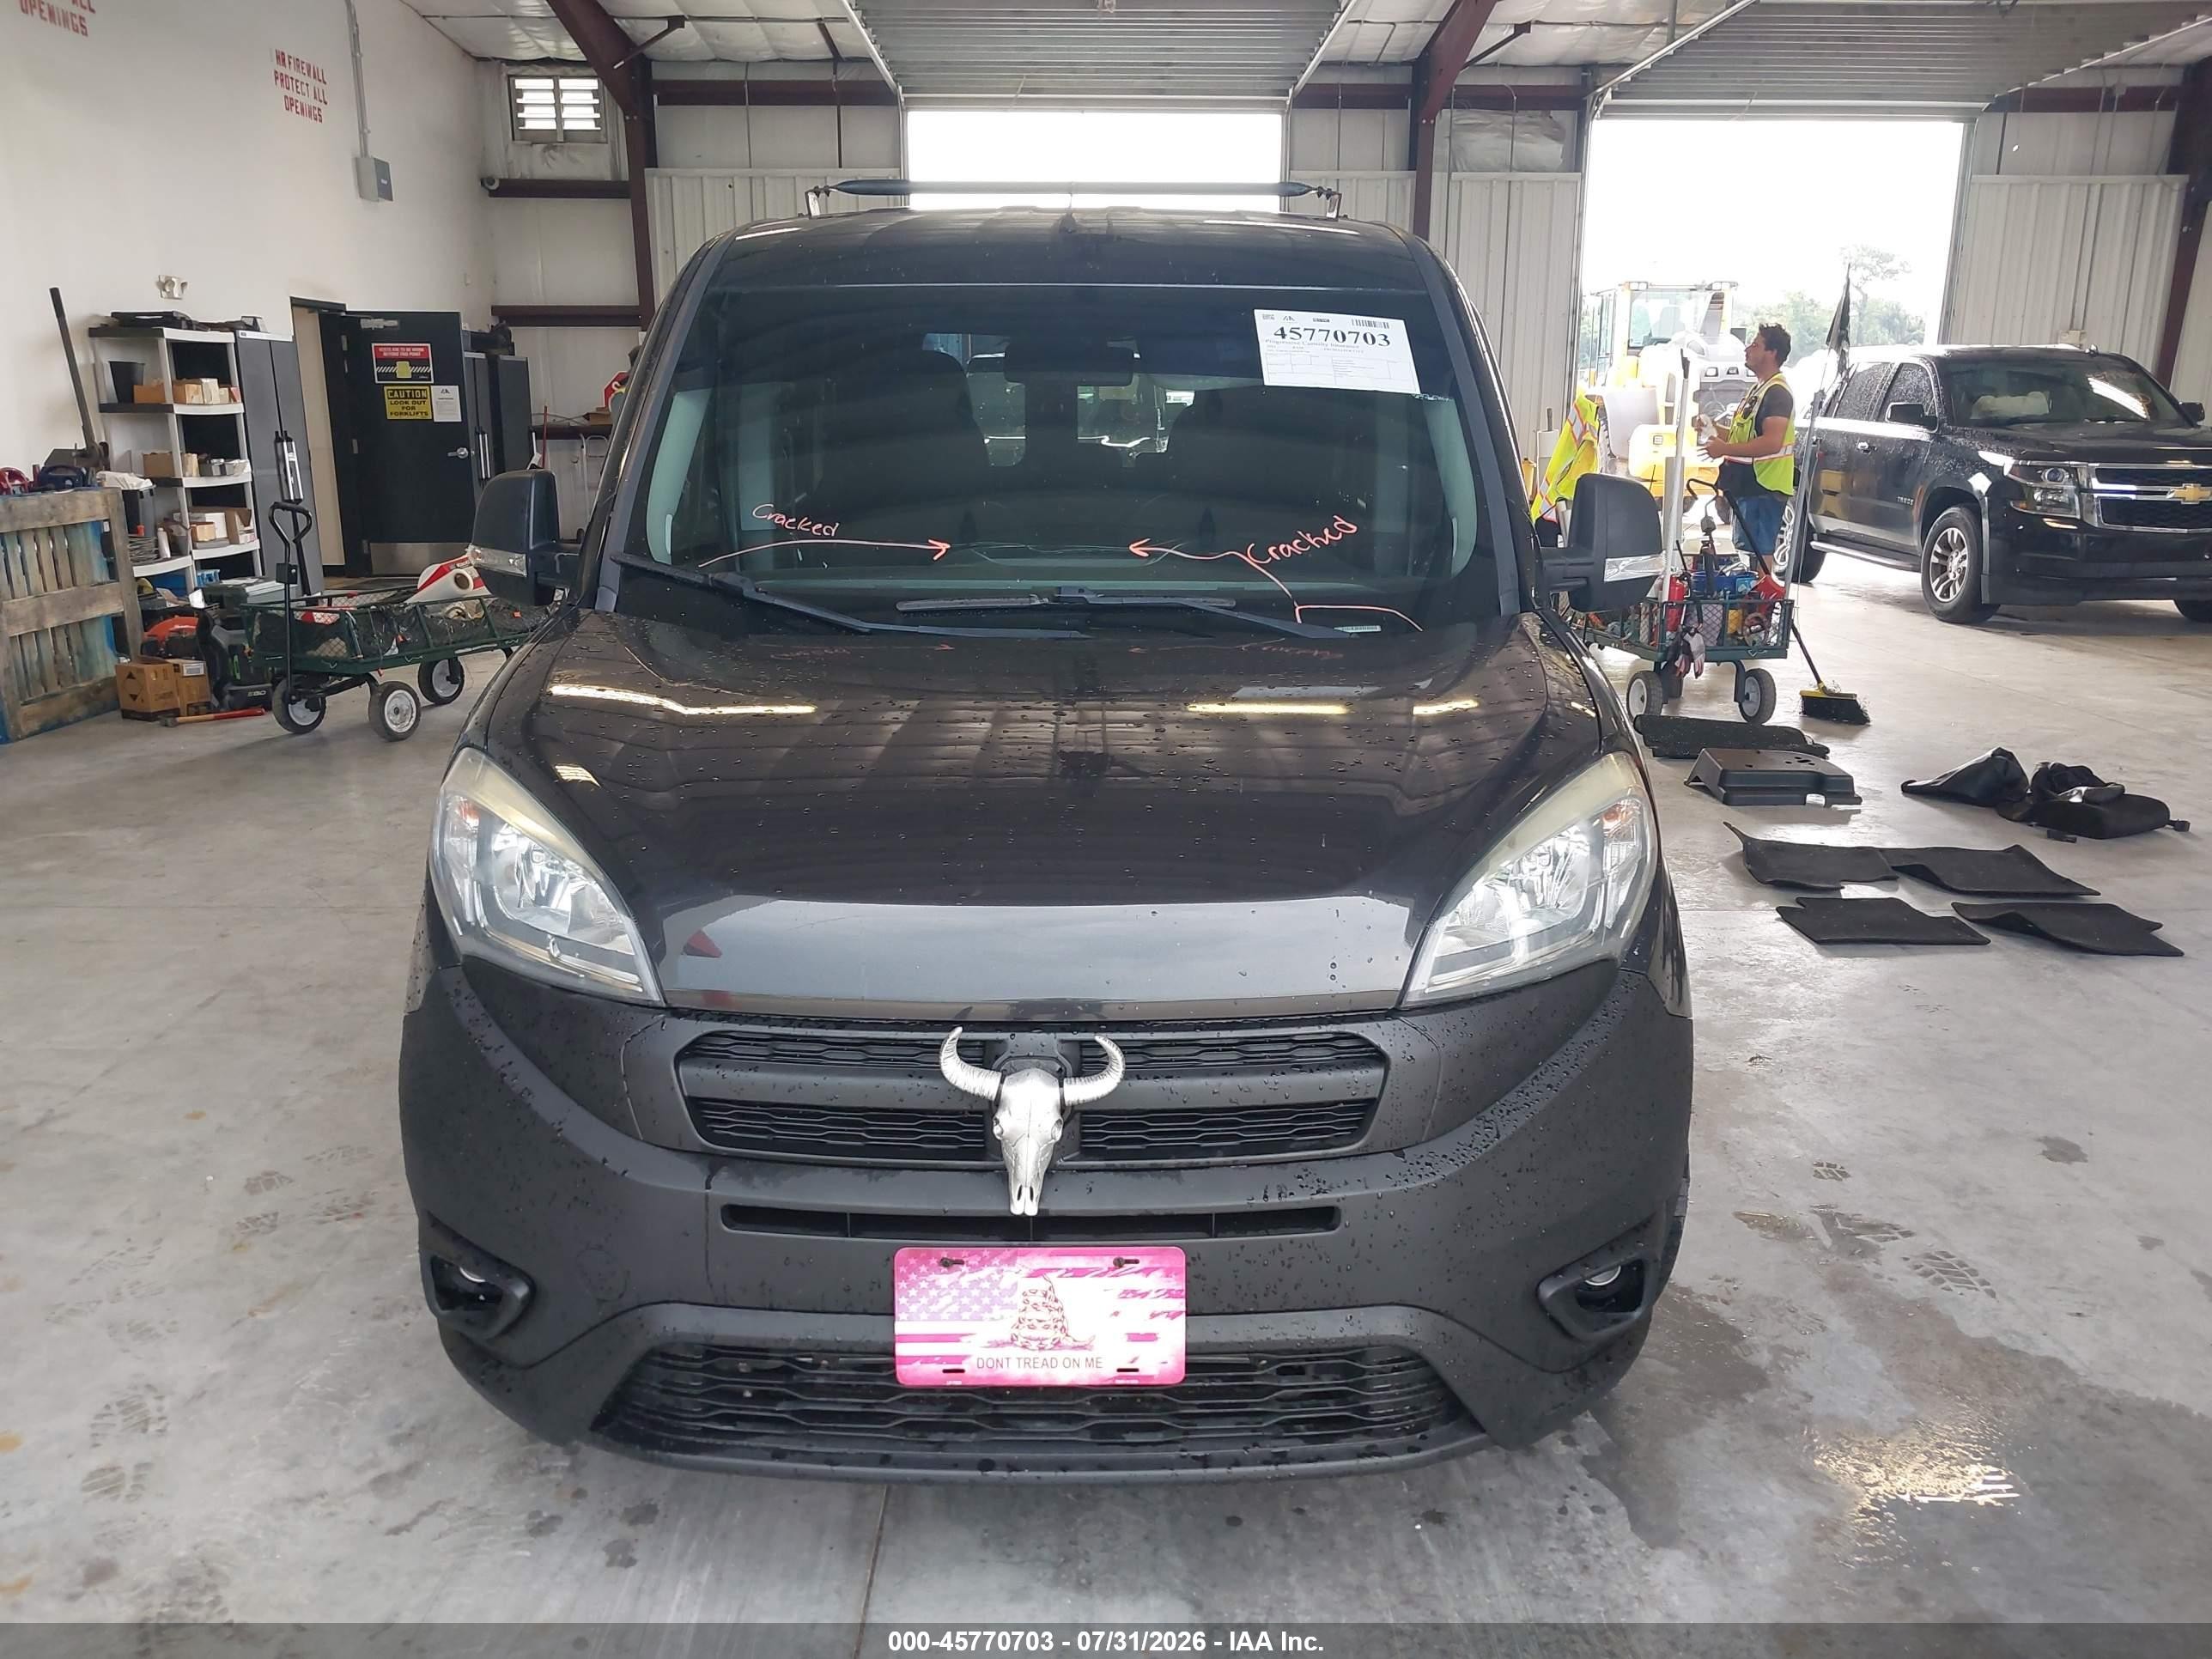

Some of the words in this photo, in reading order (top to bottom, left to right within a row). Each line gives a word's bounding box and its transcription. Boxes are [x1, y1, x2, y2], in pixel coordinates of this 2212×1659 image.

[20, 0, 88, 37] OPENINGS
[287, 54, 327, 85] FIREWALL
[274, 69, 310, 98] PROTECT
[313, 85, 328, 105] ALL
[283, 94, 323, 124] OPENINGS
[1273, 326, 1391, 347] 45770703
[387, 389, 428, 399] CAUTION
[752, 503, 840, 537] Cracked
[976, 1357, 1012, 1370] DONT
[1016, 1357, 1059, 1370] TREAD
[1062, 1357, 1081, 1370] ON
[1085, 1357, 1104, 1370] ME
